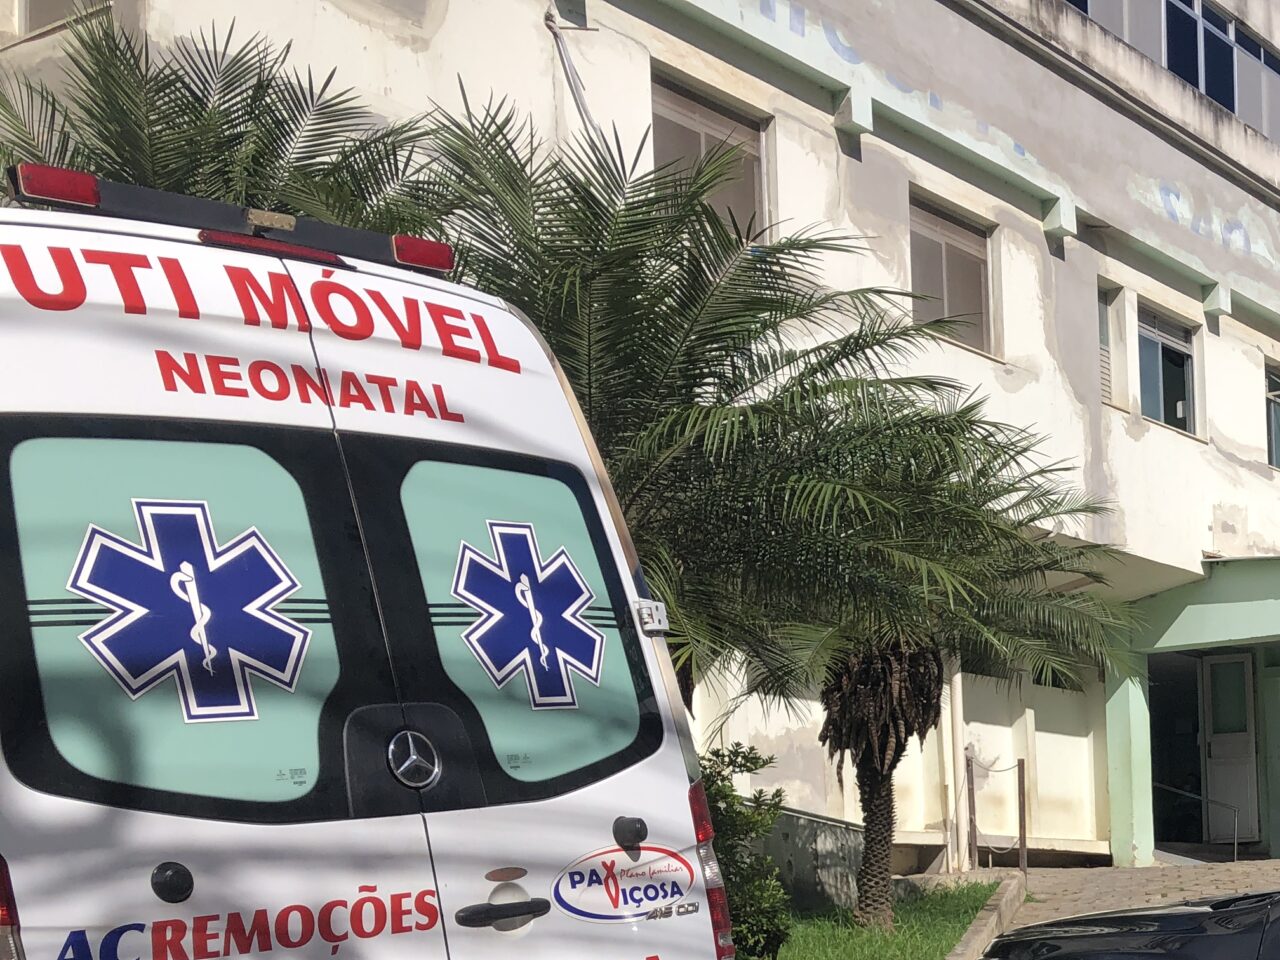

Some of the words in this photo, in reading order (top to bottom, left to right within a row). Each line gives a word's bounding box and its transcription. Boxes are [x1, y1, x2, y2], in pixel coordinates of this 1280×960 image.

[0, 244, 200, 320] UTI
[223, 265, 522, 374] MÓVEL
[154, 350, 466, 423] NEONATAL
